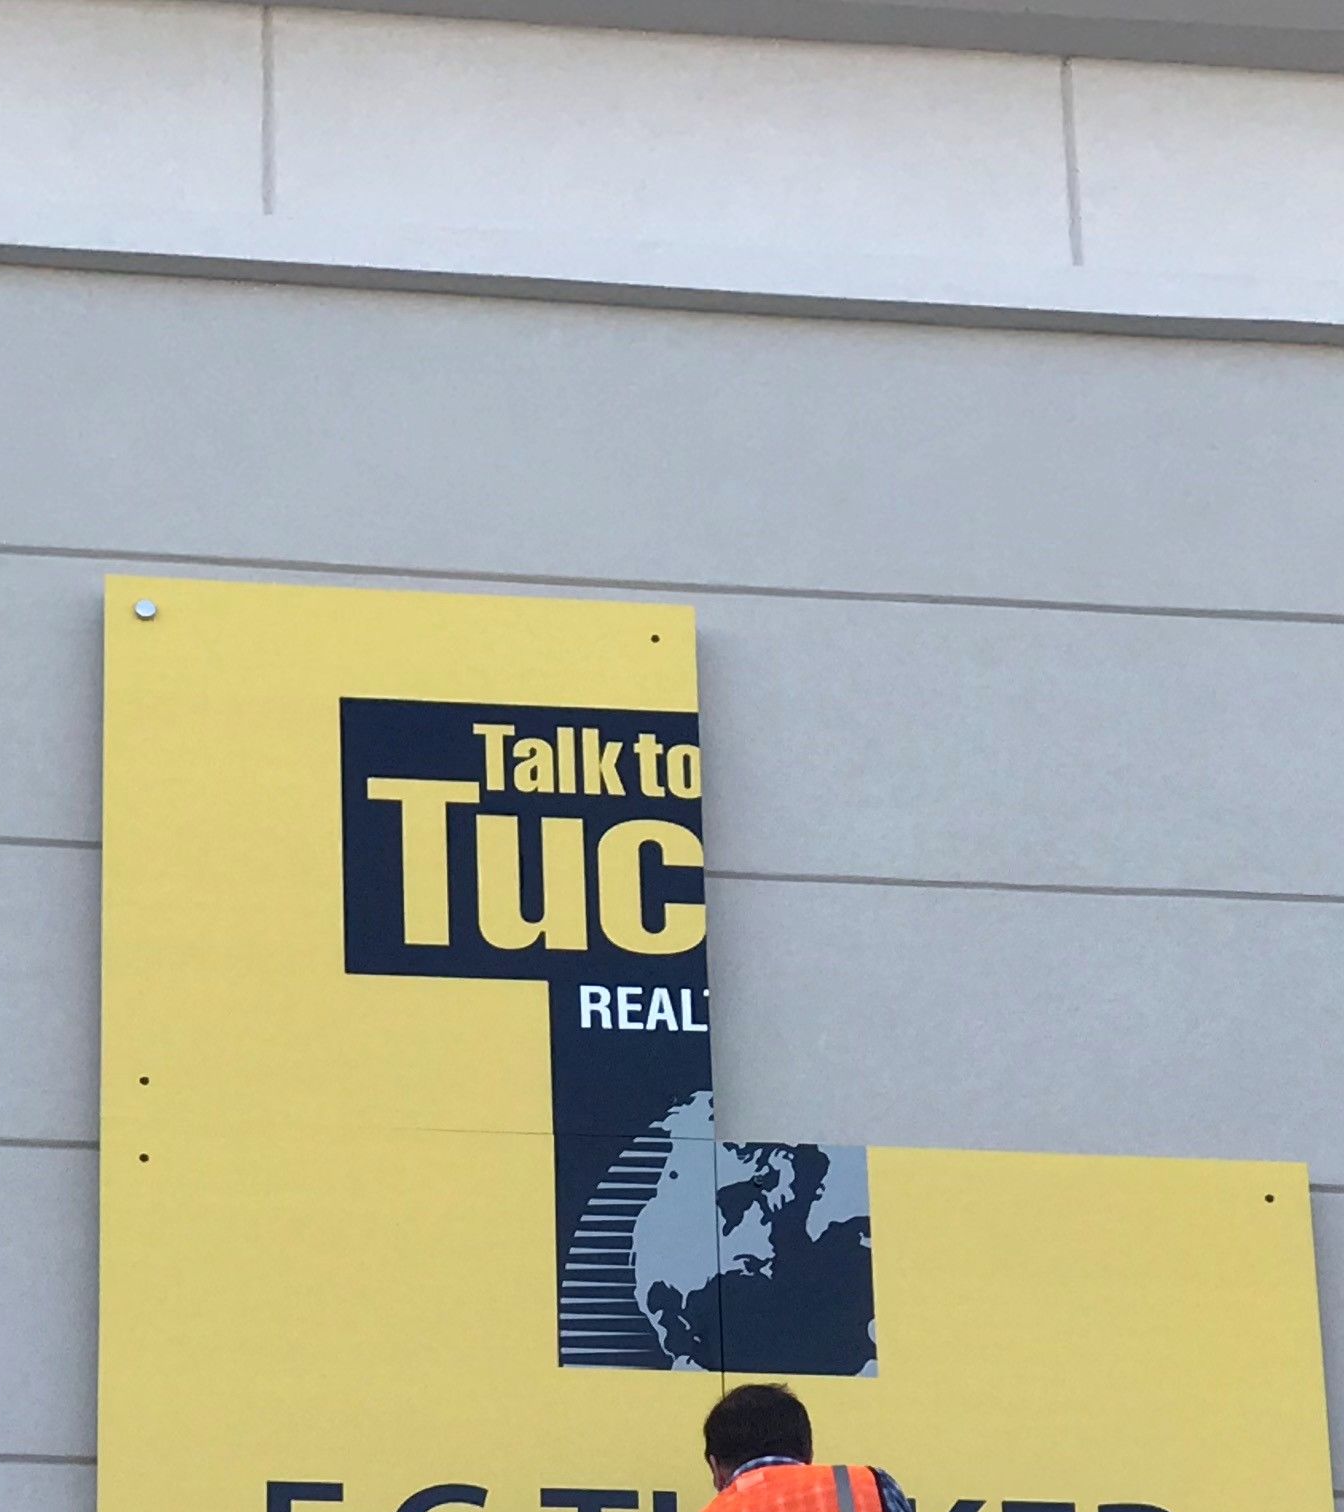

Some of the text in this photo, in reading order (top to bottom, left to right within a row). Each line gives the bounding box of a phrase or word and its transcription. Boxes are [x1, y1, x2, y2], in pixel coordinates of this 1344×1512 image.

[472, 722, 703, 800] Talk to
[579, 984, 710, 1032] REAL
